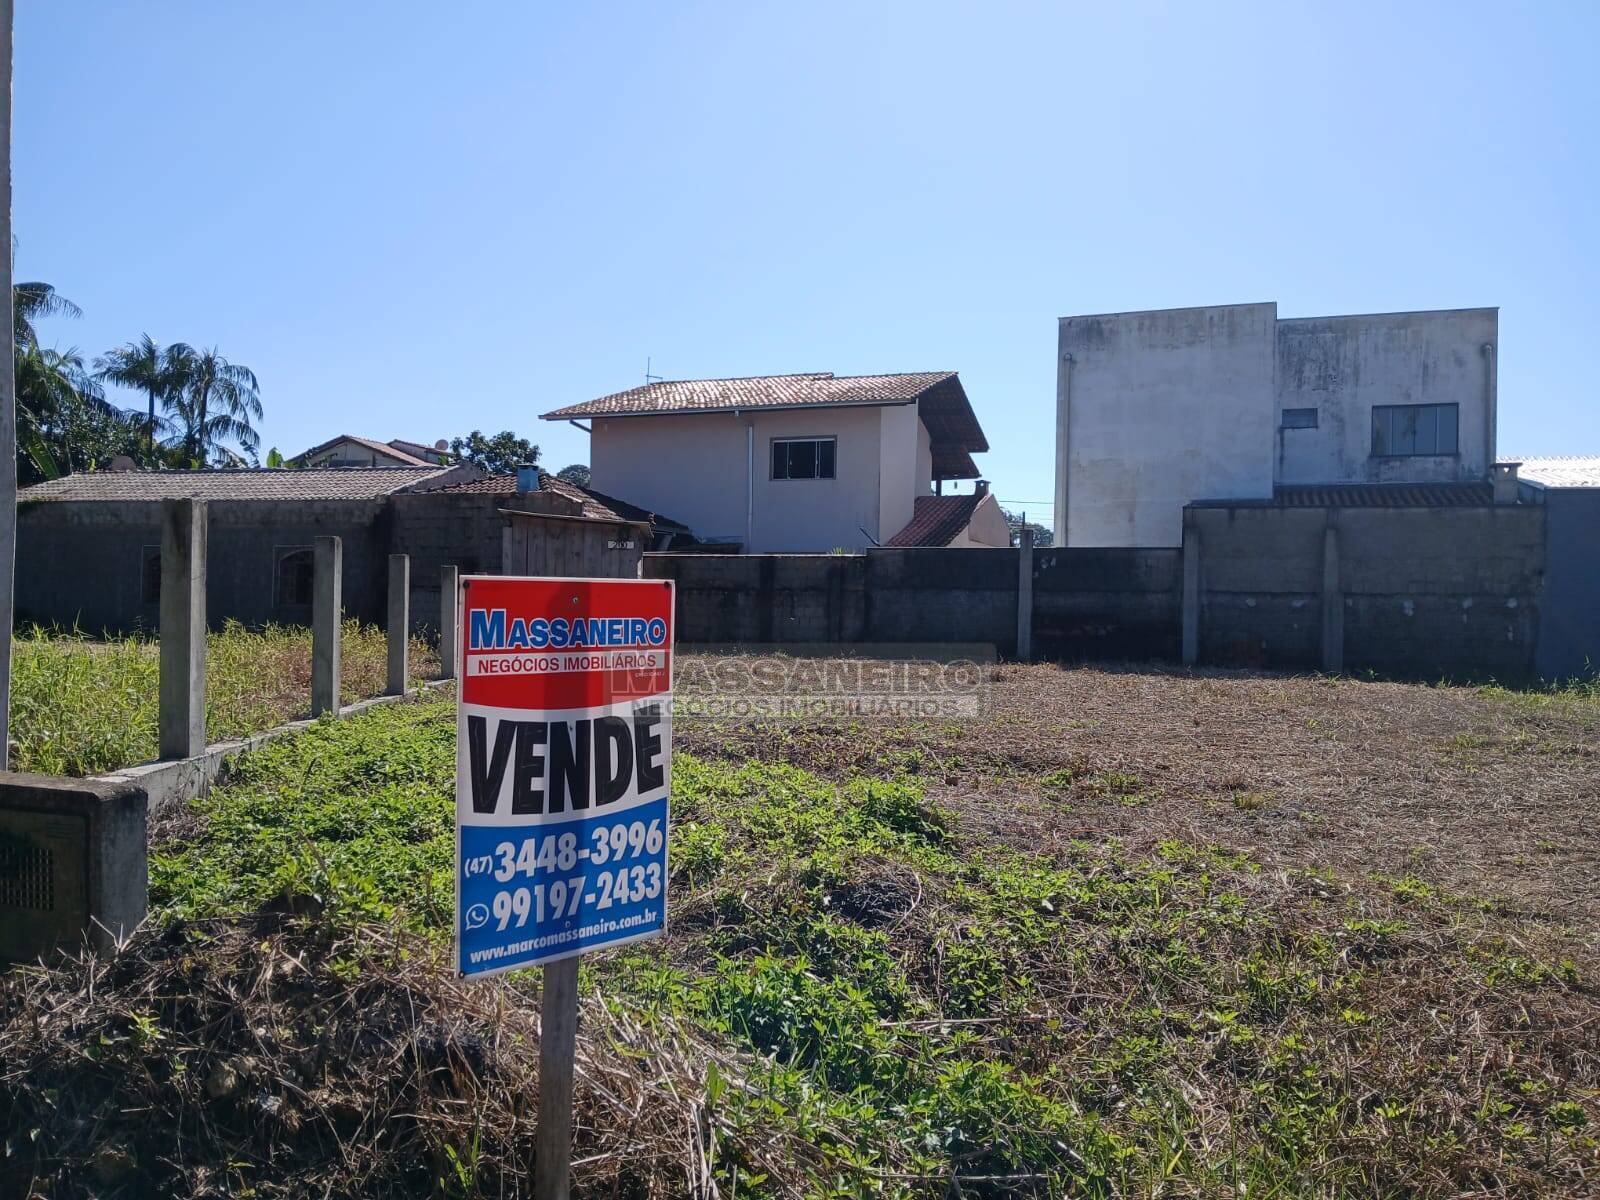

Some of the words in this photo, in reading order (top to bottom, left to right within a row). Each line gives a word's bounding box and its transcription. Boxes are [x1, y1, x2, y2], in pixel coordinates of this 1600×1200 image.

[469, 608, 667, 650] MASSANEIRO
[477, 655, 560, 674] NEGÓCIOS
[563, 653, 656, 671] IMOBILIÁRIOS
[467, 703, 665, 815] VENDE
[464, 855, 493, 878] (47)
[494, 818, 664, 883] 3448-3996
[492, 862, 661, 932] 99197-2433
[469, 908, 658, 964] www.marcomassaneiro.com.br
